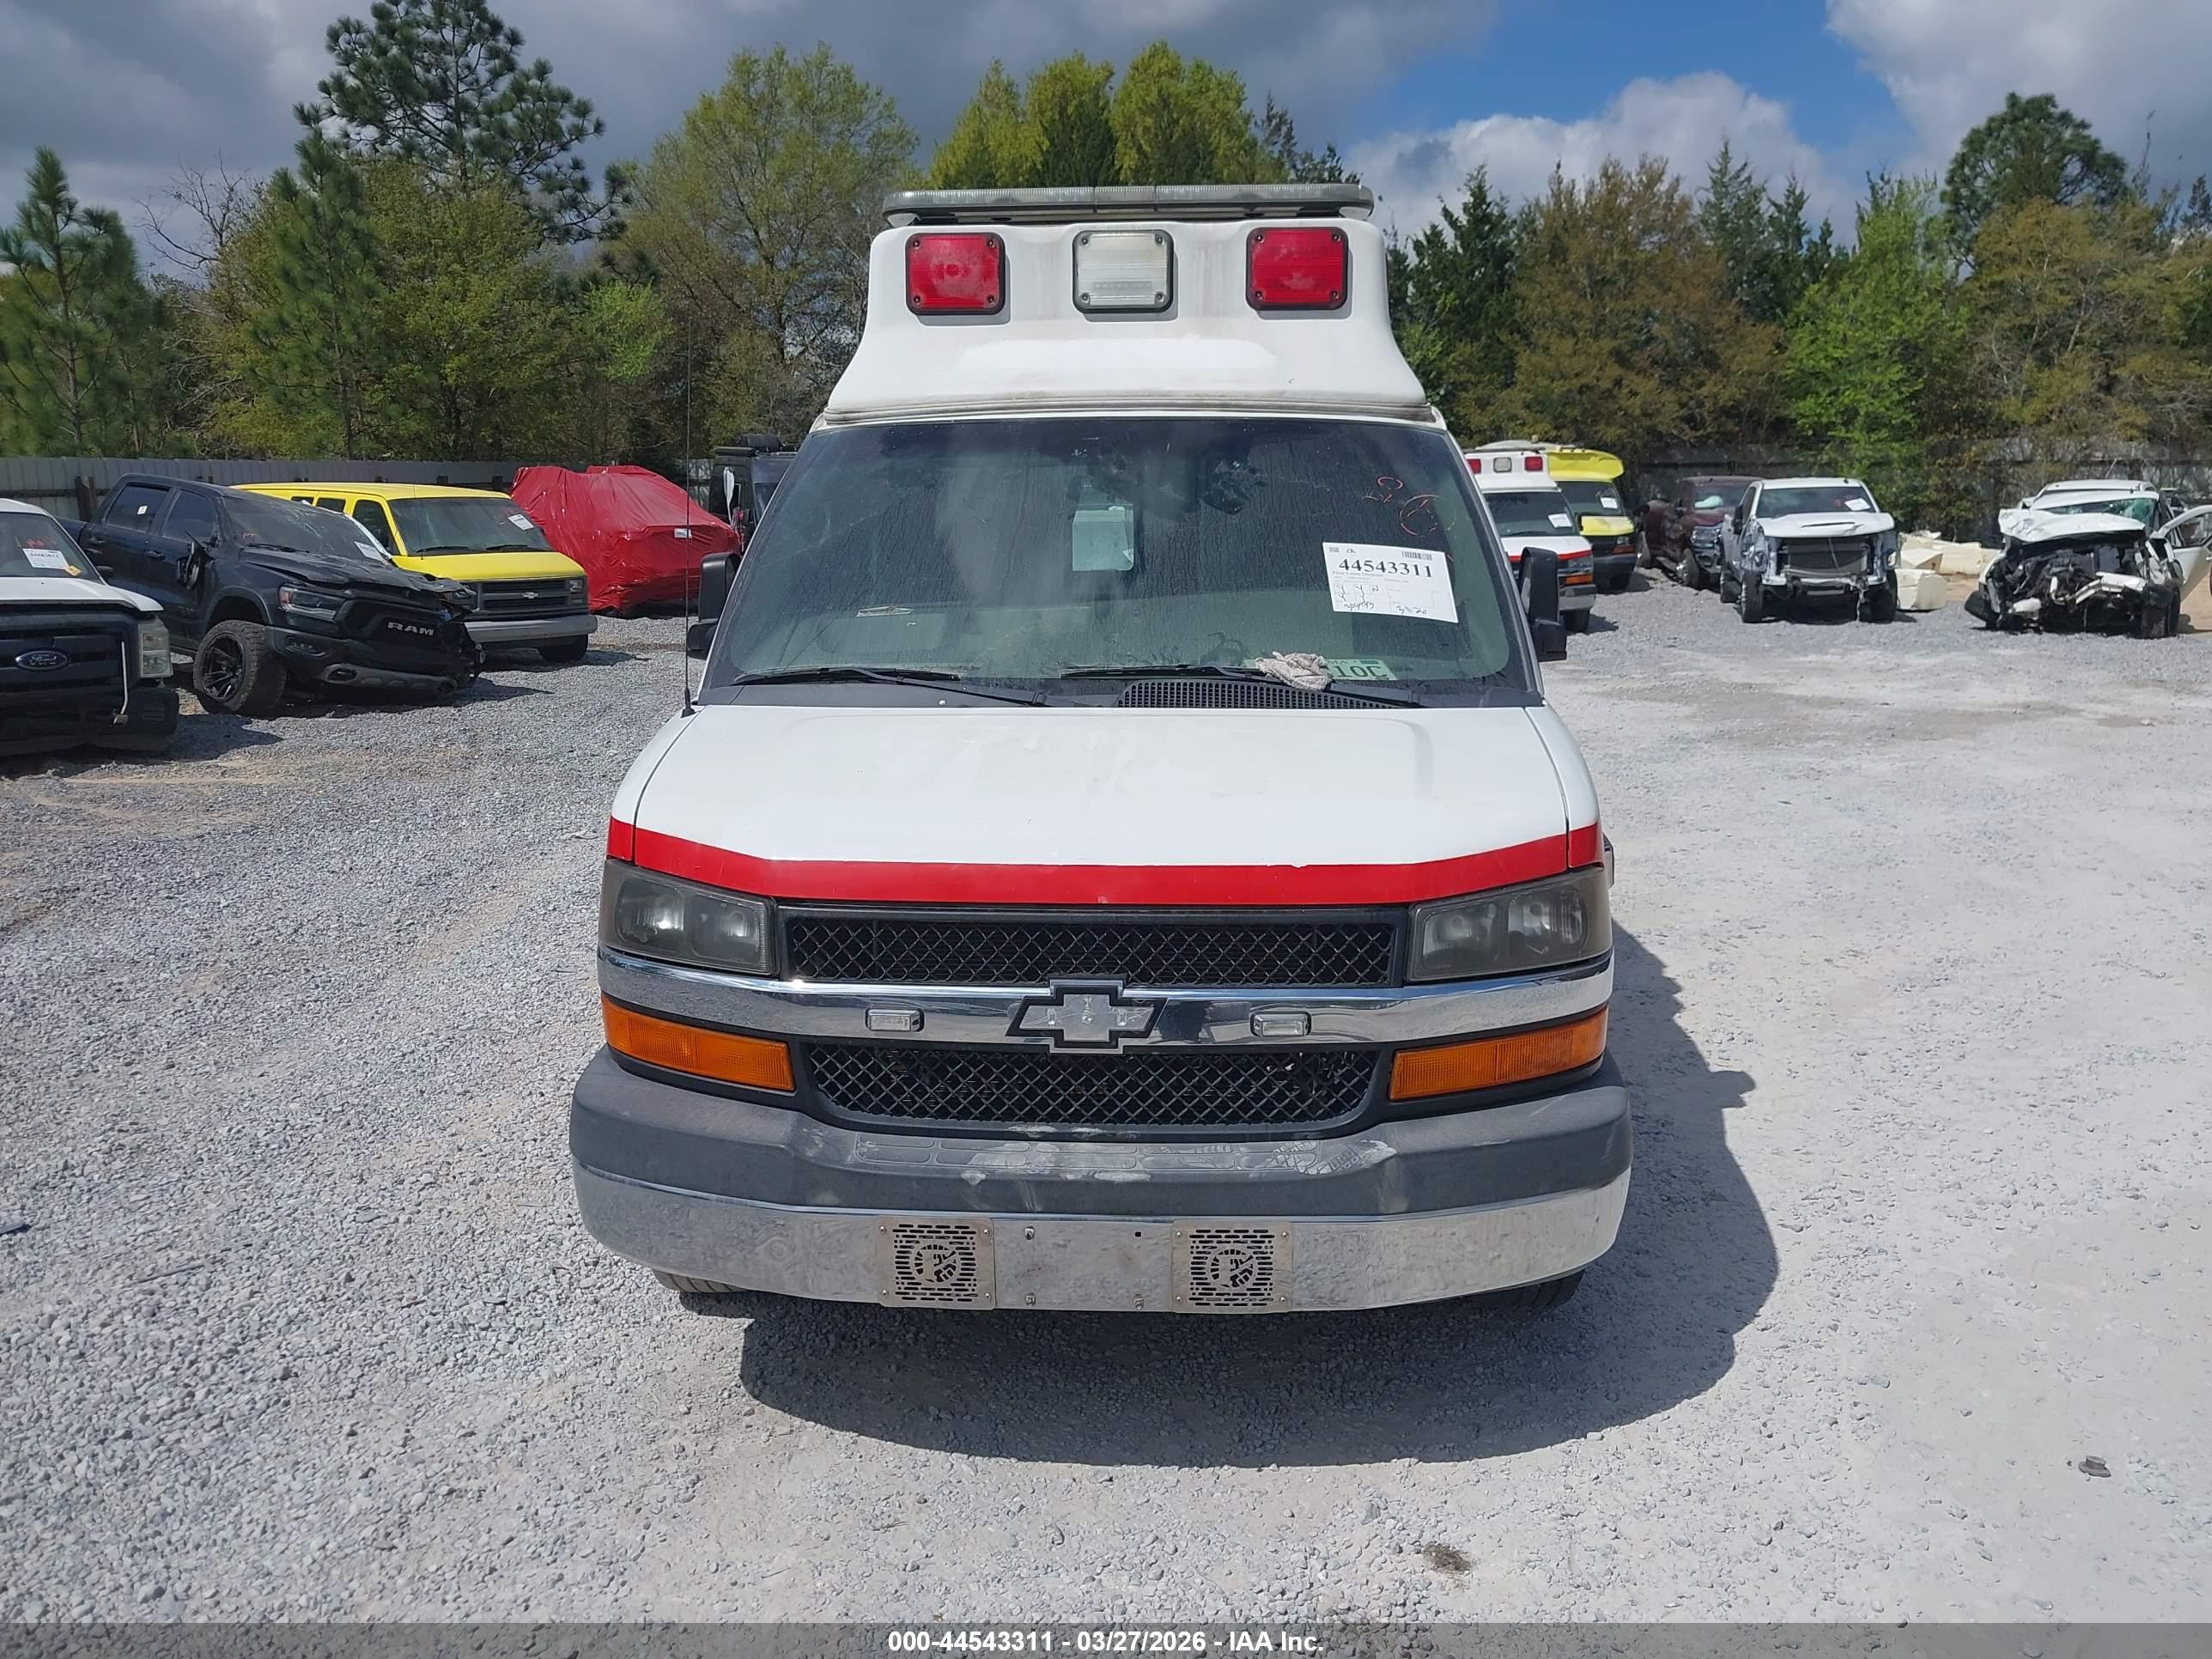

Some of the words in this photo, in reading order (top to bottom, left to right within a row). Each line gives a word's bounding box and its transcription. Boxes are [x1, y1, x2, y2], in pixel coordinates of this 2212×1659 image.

[1339, 558, 1431, 578] 44543311
[387, 622, 434, 635] RAM
[29, 653, 57, 665] Ford
